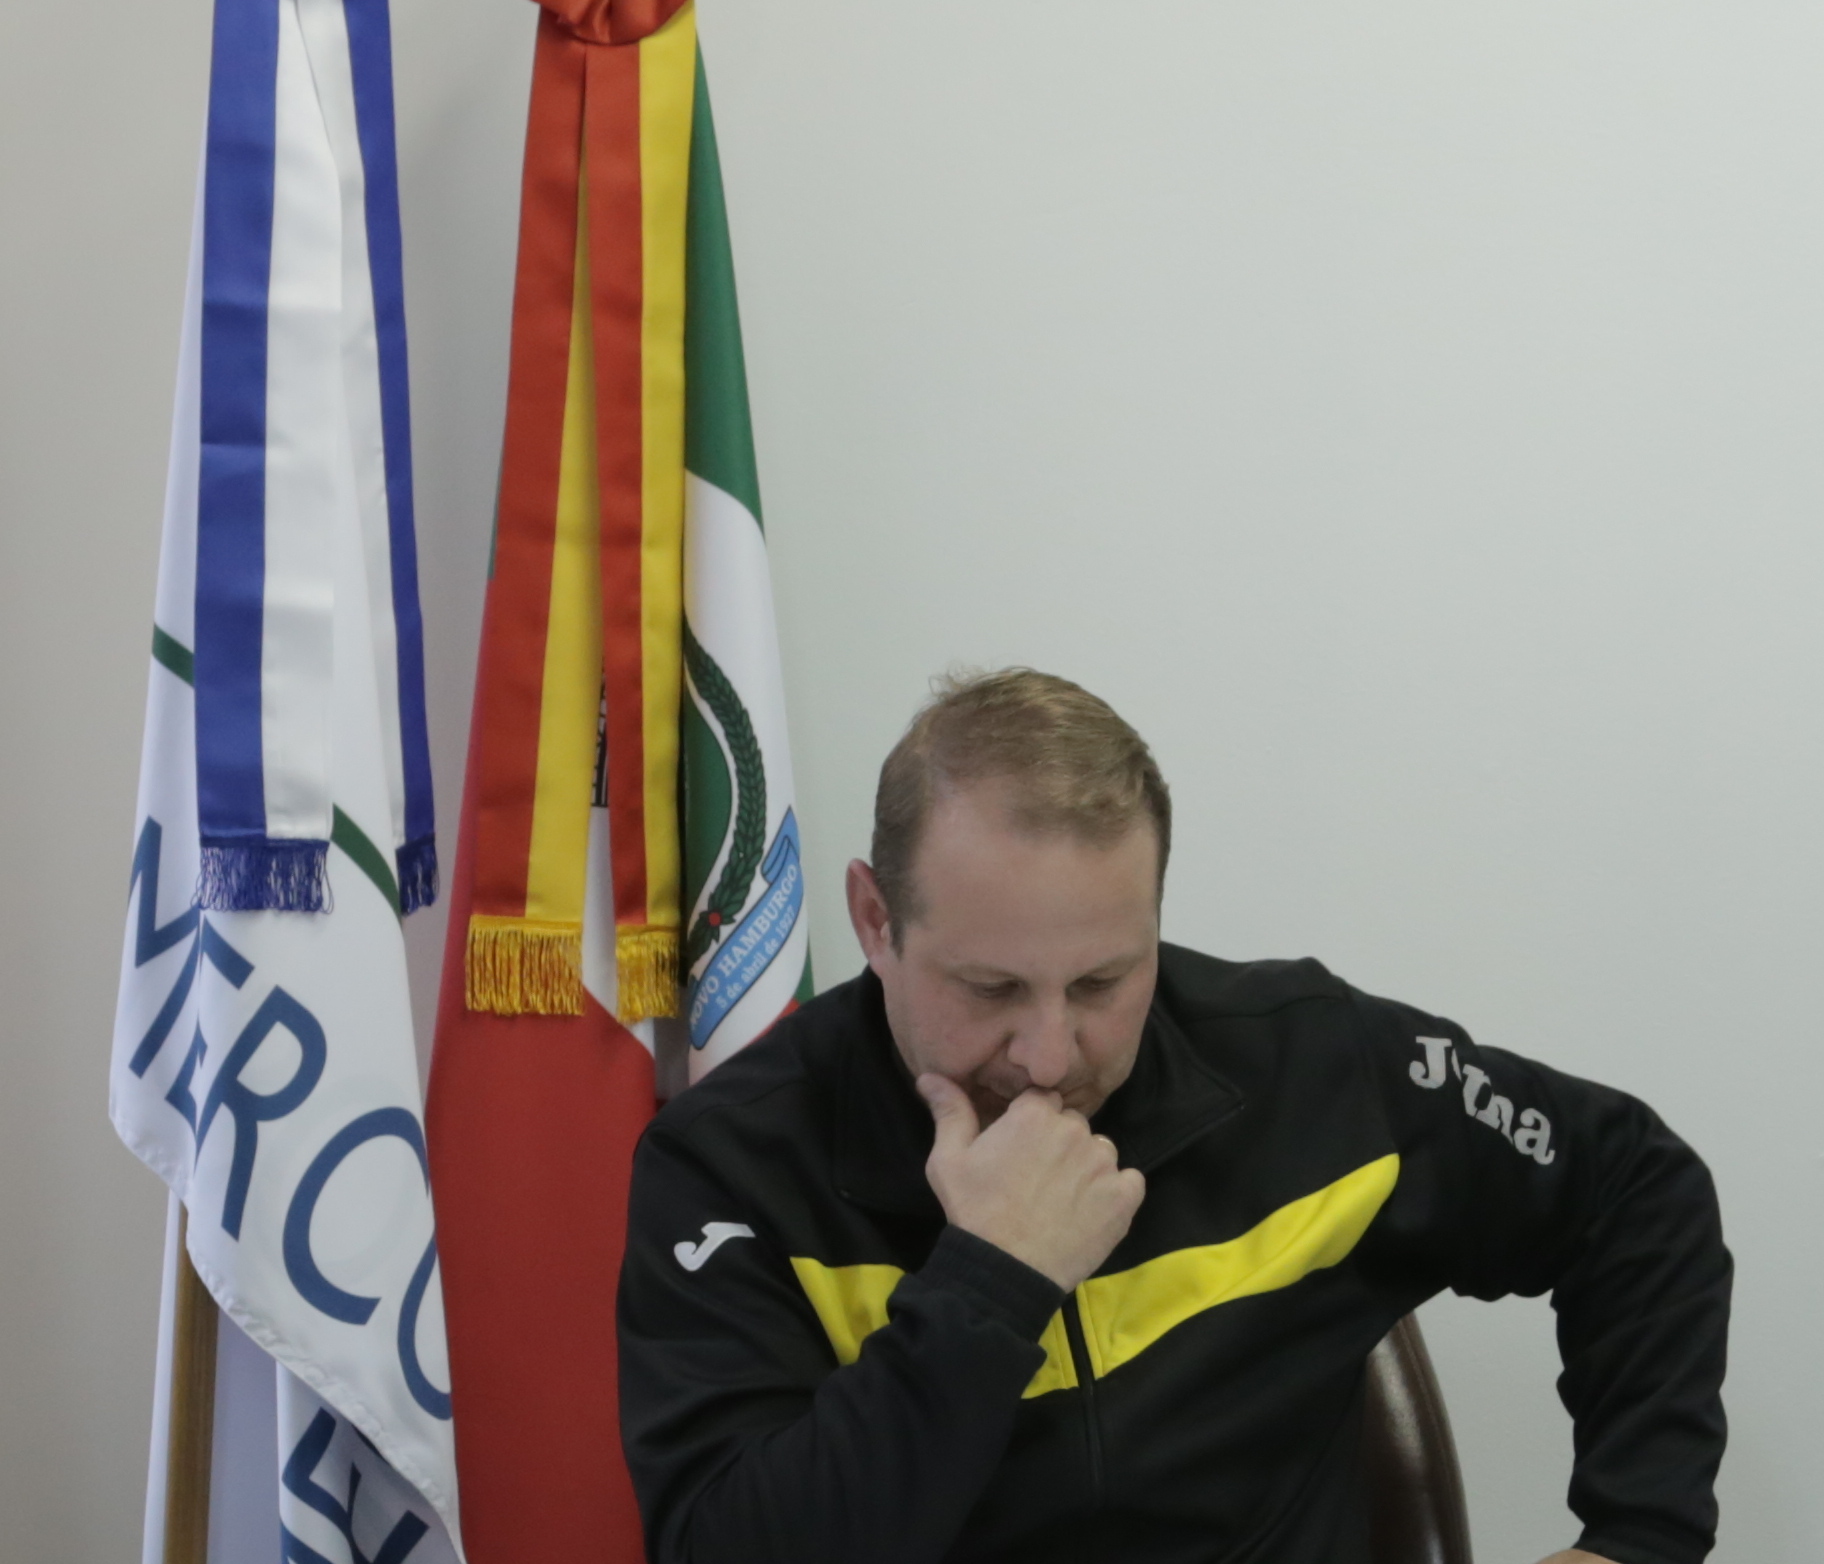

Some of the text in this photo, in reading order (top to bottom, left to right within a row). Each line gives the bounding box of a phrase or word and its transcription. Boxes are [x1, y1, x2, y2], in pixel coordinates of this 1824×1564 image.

[717, 864, 798, 978] HAMBURGO
[727, 981, 743, 999] de
[741, 951, 767, 986] abril
[764, 935, 779, 954] de
